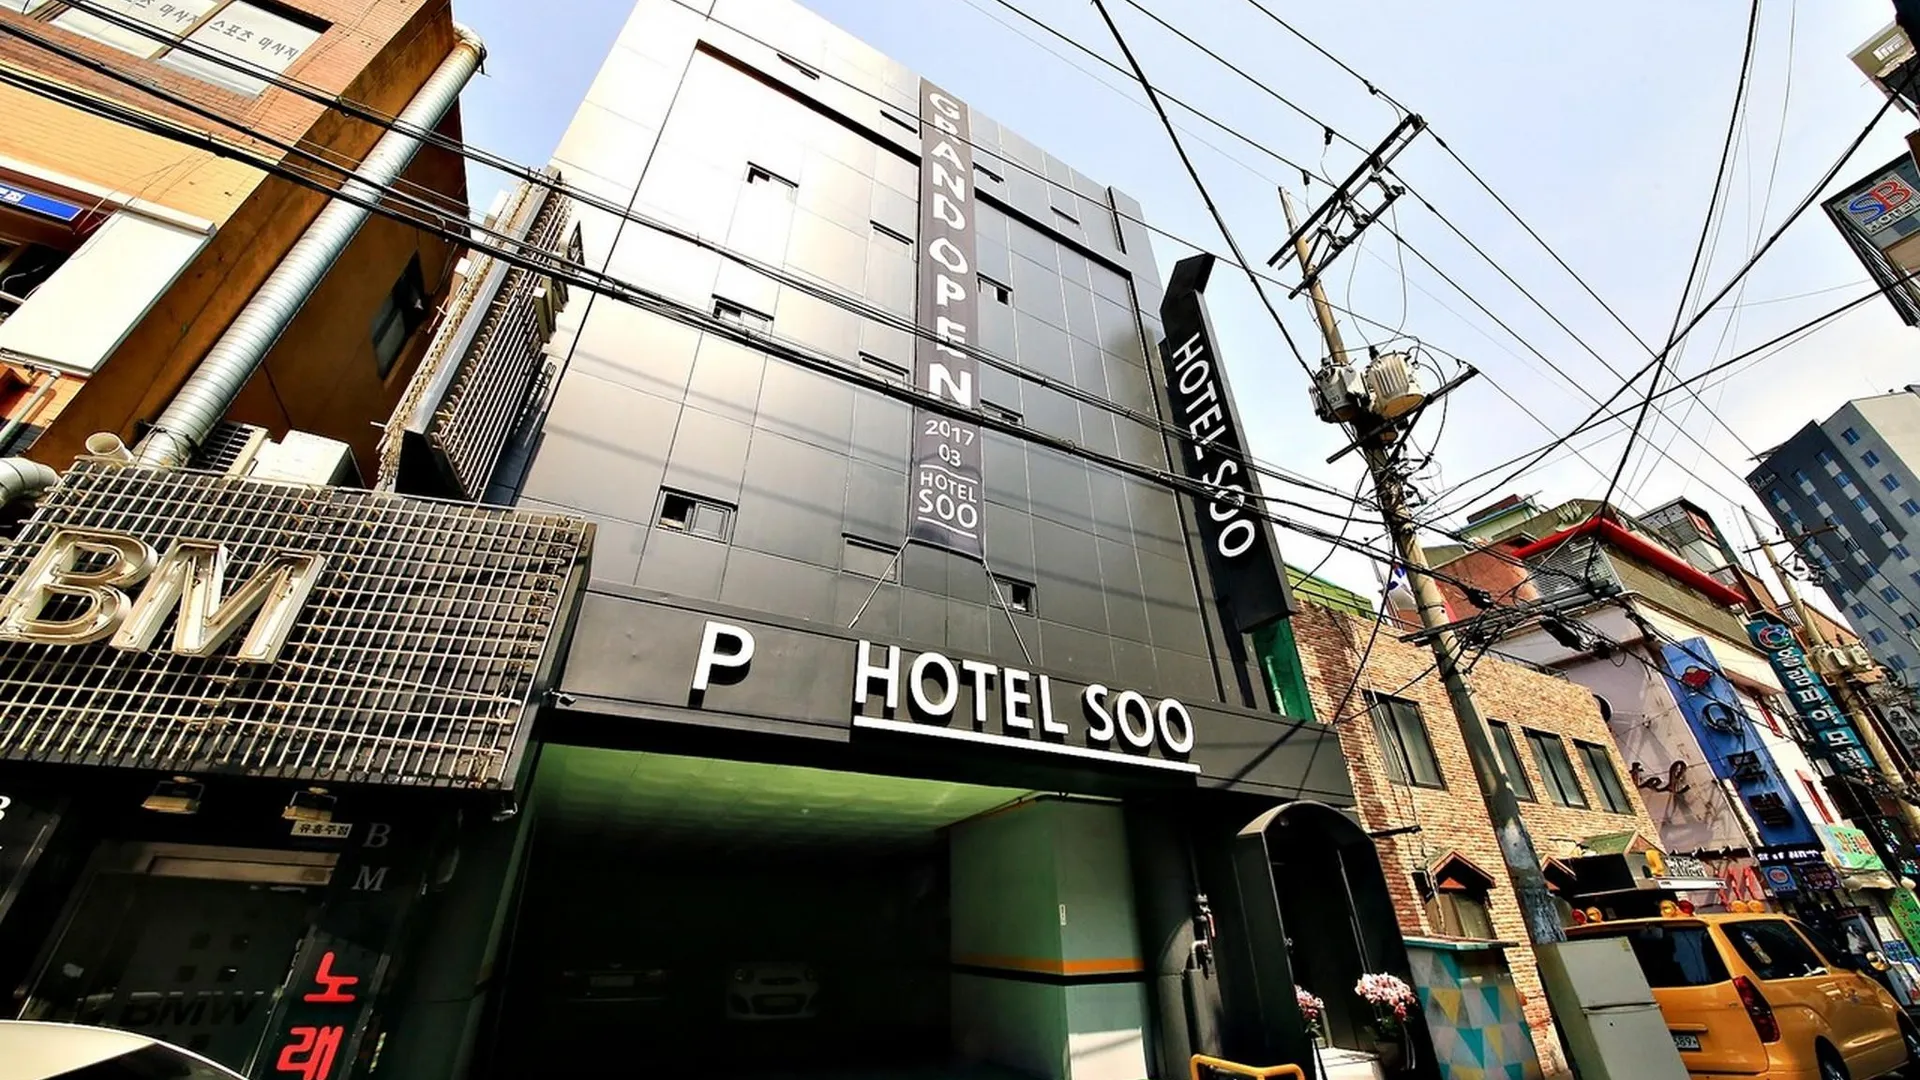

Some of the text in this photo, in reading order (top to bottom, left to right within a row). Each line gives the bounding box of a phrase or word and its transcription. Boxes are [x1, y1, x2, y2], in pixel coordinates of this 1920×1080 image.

[209, 20, 300, 61] 스포츠 마사지
[1849, 180, 1912, 224] SB
[928, 92, 969, 410] GRAND OPEN
[924, 420, 975, 446] 2017
[1172, 332, 1256, 558] HOTEL SOO
[938, 443, 962, 468] 03
[917, 488, 978, 529] SOO
[919, 471, 977, 504] HOTEL
[0, 524, 326, 665] BM
[692, 620, 756, 692] P
[854, 639, 1195, 754] HOTEL SOO
[299, 822, 349, 836] 유흥주점
